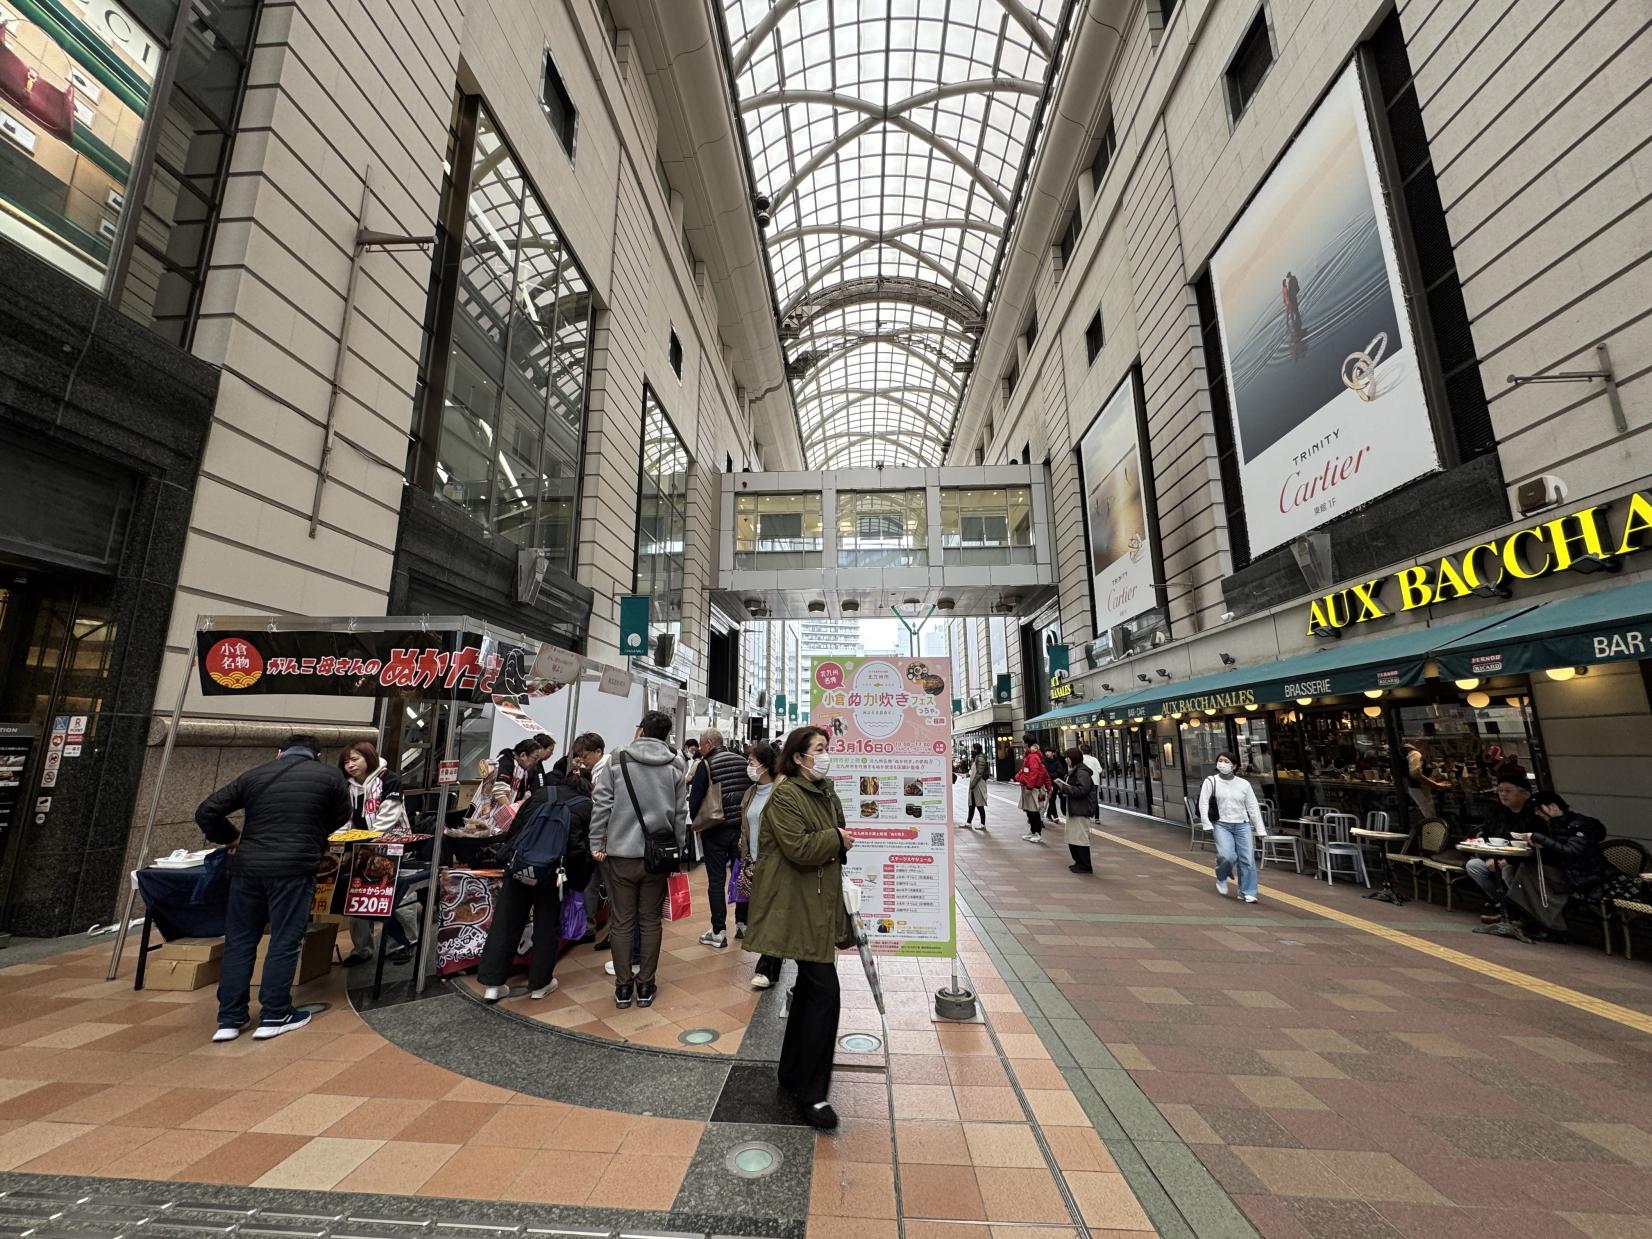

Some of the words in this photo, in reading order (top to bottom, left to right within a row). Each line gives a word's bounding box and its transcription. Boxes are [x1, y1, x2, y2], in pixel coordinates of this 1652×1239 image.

[1292, 427, 1342, 466] TRINITY
[1279, 445, 1371, 514] Cartier
[1111, 571, 1128, 585] TRINITY
[1107, 585, 1138, 612] Cartier
[1306, 580, 1392, 637] AUX
[220, 642, 248, 656] 小倉
[1593, 631, 1645, 658] BAR
[221, 656, 250, 670] 名物
[1284, 679, 1331, 698] BRASSERIE
[1161, 701, 1178, 715] AUX
[1179, 689, 1255, 713] BACCHANALES
[349, 896, 389, 913] 520円
